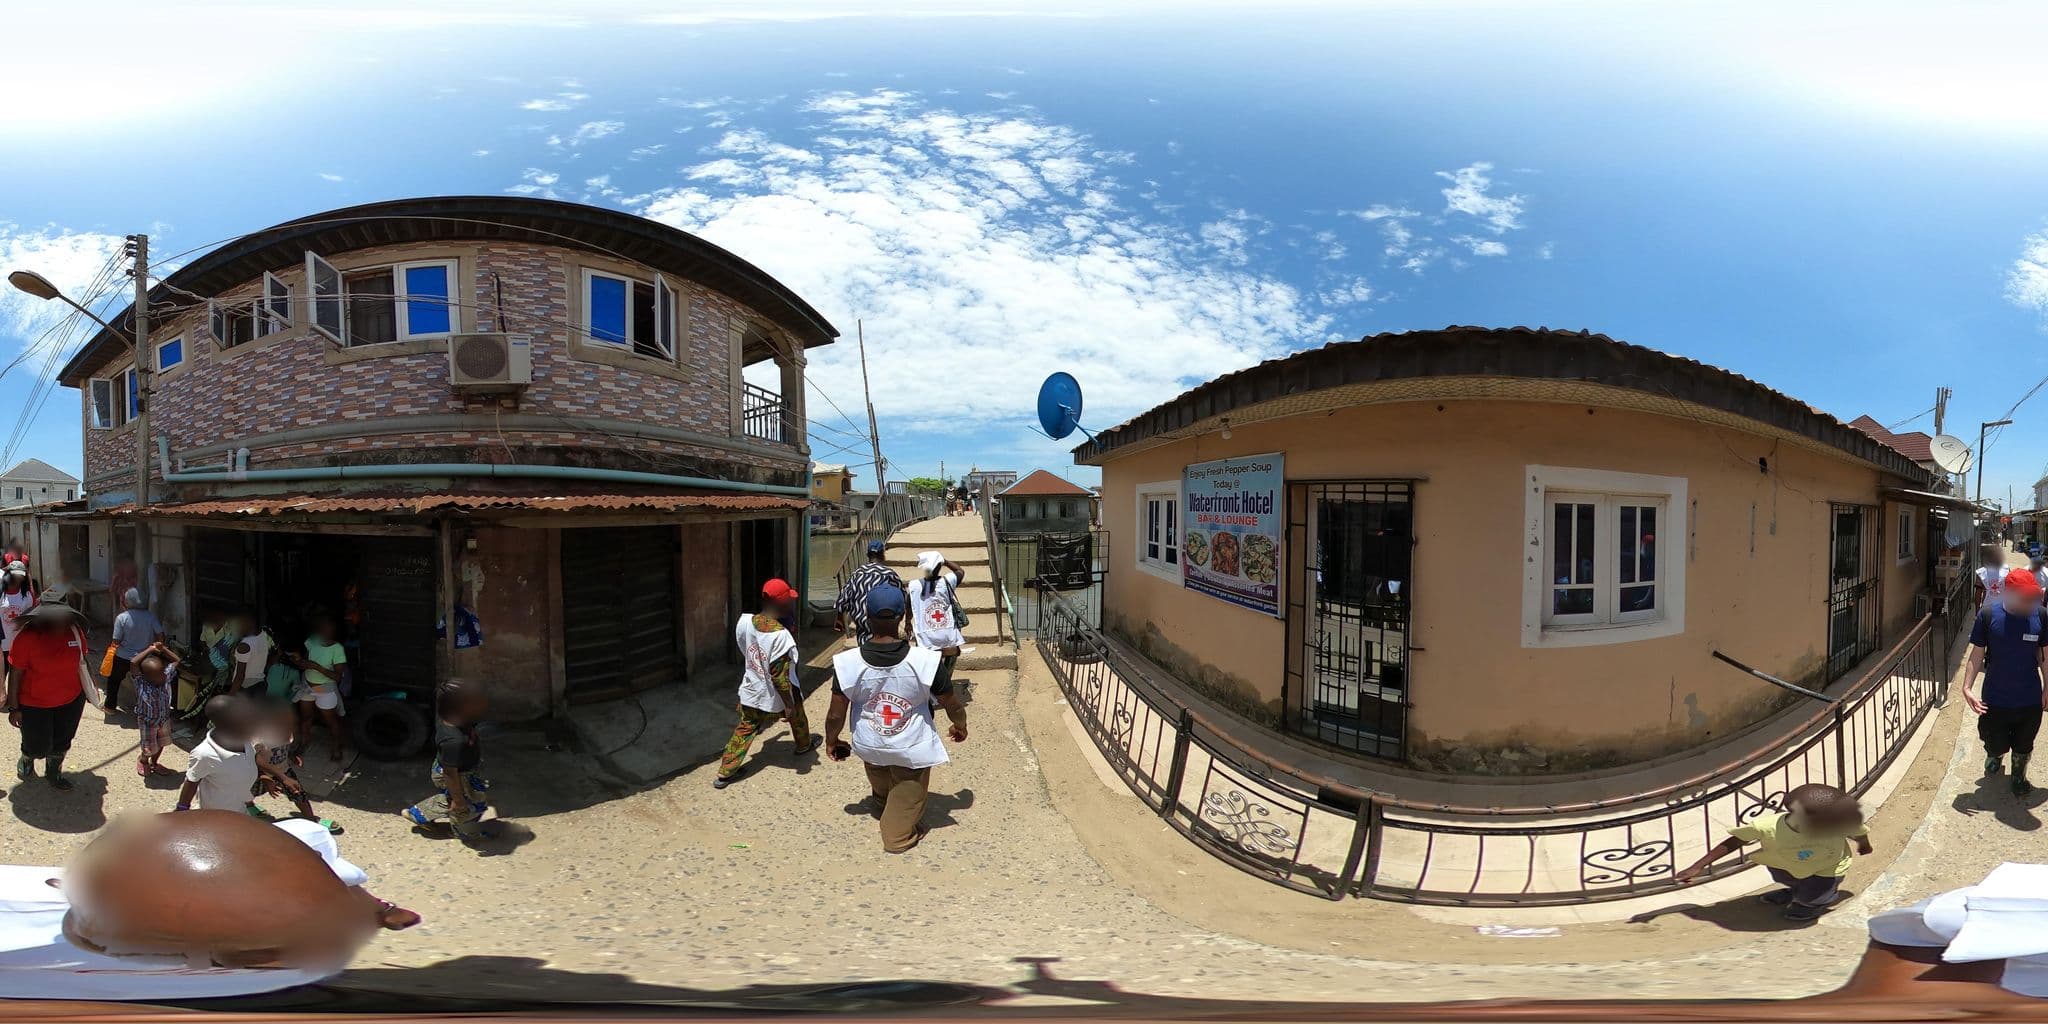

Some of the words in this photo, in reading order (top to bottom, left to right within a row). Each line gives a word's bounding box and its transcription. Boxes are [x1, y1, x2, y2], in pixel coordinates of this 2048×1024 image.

[1190, 470, 1206, 479] Enjoy
[1207, 467, 1224, 477] Fresh
[1225, 465, 1249, 476] Pepper
[1251, 463, 1272, 474] Soup
[1213, 480, 1232, 490] Today
[1234, 480, 1240, 488] @
[1189, 491, 1240, 513] Waterfront
[1242, 490, 1274, 514] Hotel
[1197, 514, 1212, 523] BAR
[1214, 514, 1220, 523] &
[1222, 515, 1258, 526] LOUNGE
